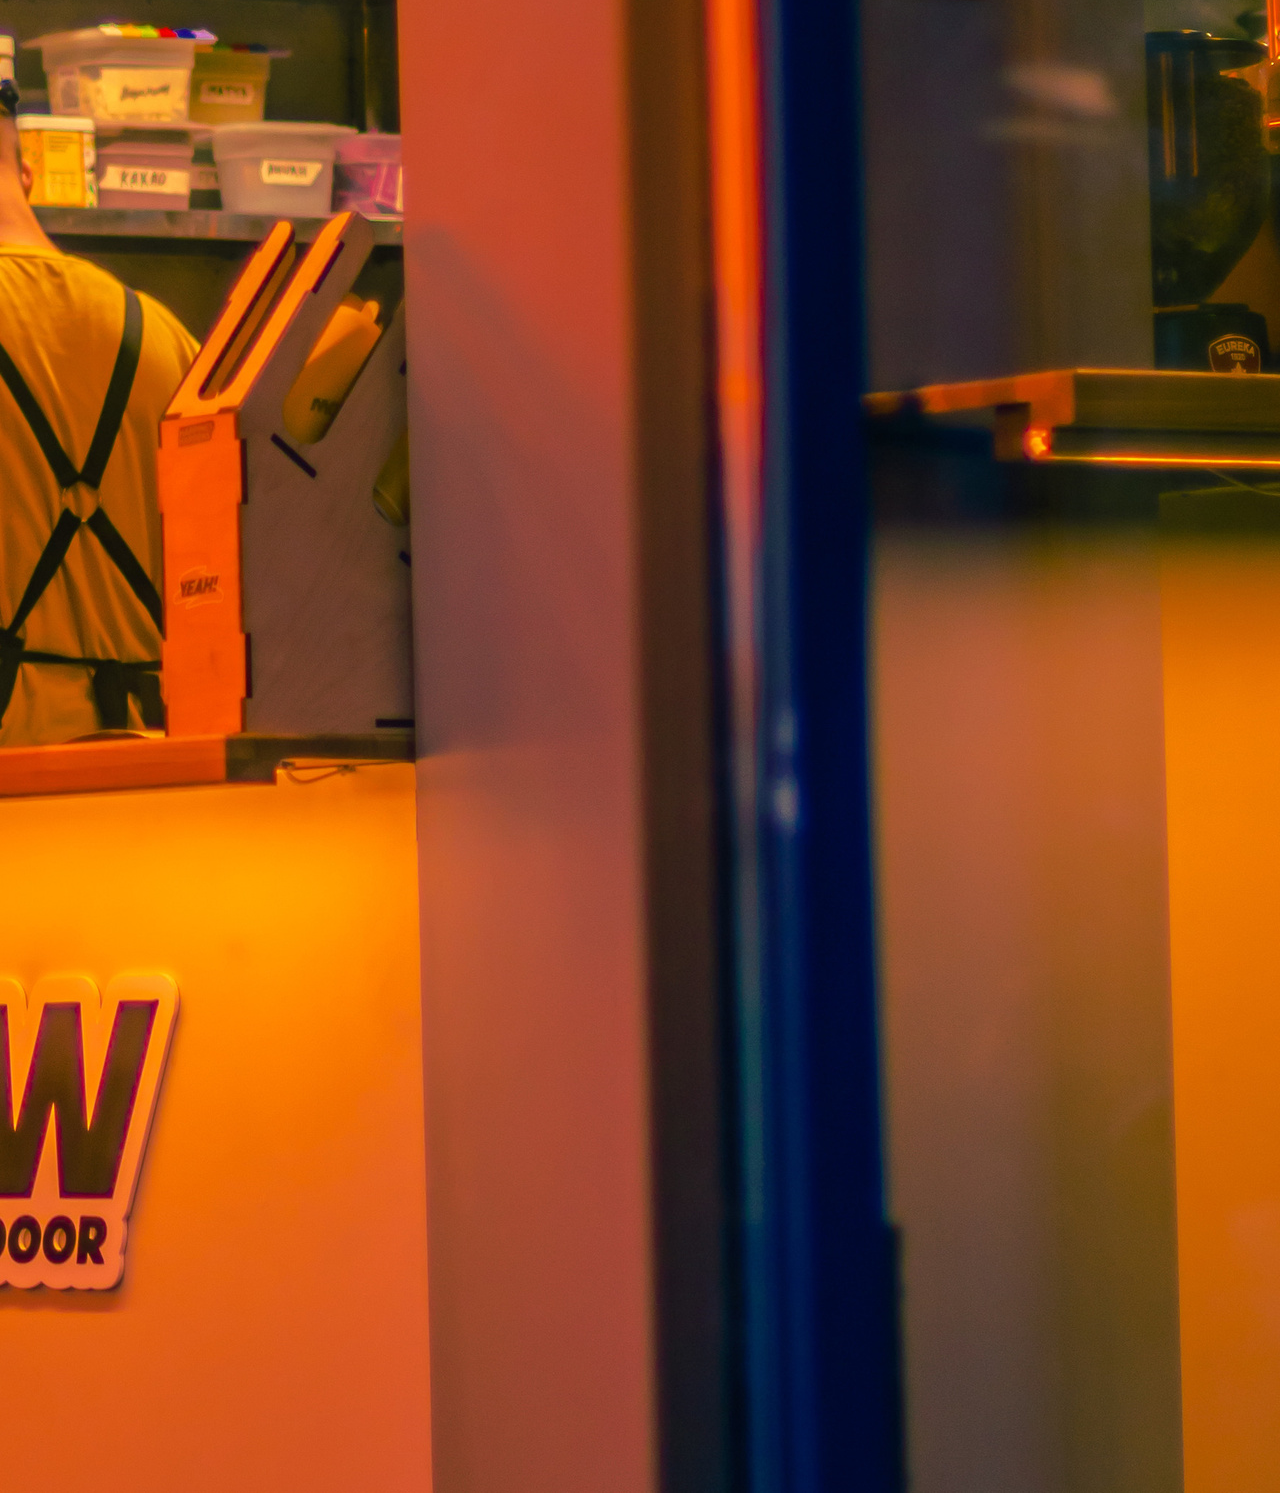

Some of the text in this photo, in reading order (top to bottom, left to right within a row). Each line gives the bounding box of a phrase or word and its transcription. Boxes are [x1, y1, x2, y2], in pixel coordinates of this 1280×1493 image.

[120, 170, 167, 187] КАКАО
[1215, 340, 1255, 357] EUREKA
[179, 574, 219, 598] YEAH!
